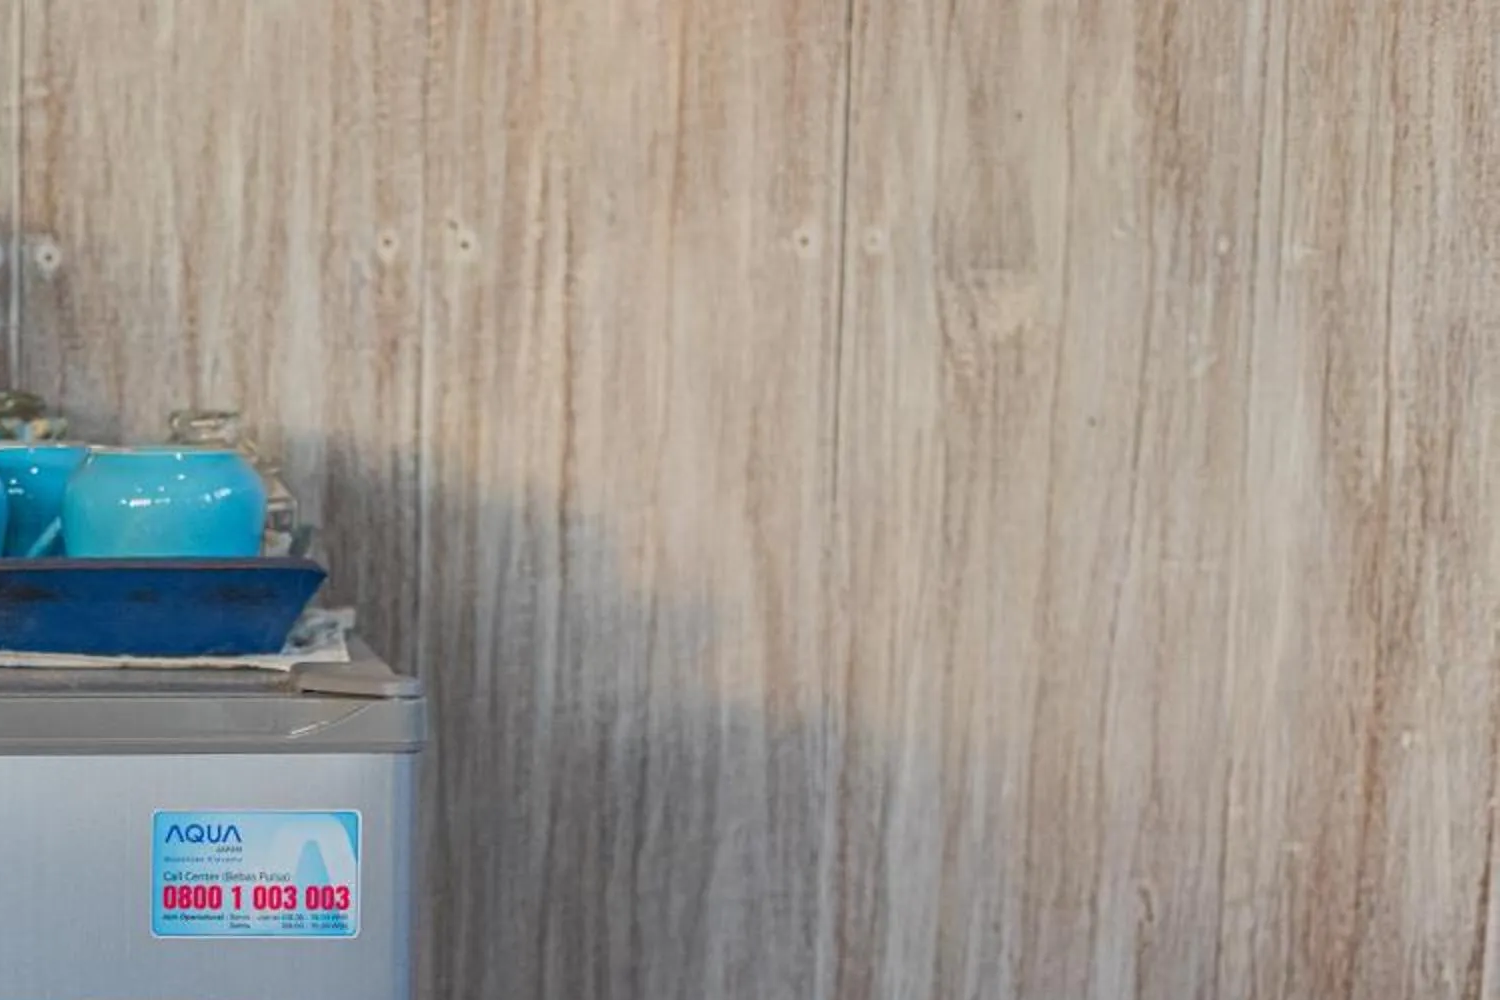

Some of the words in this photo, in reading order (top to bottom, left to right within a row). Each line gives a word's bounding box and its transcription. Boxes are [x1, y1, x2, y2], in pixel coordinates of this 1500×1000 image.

[164, 823, 243, 844] AQUA
[162, 870, 183, 882] Call
[184, 870, 220, 882] Center
[162, 884, 223, 911] 0800
[231, 885, 243, 910] 1
[253, 884, 298, 911] 003
[305, 884, 351, 911] 003
